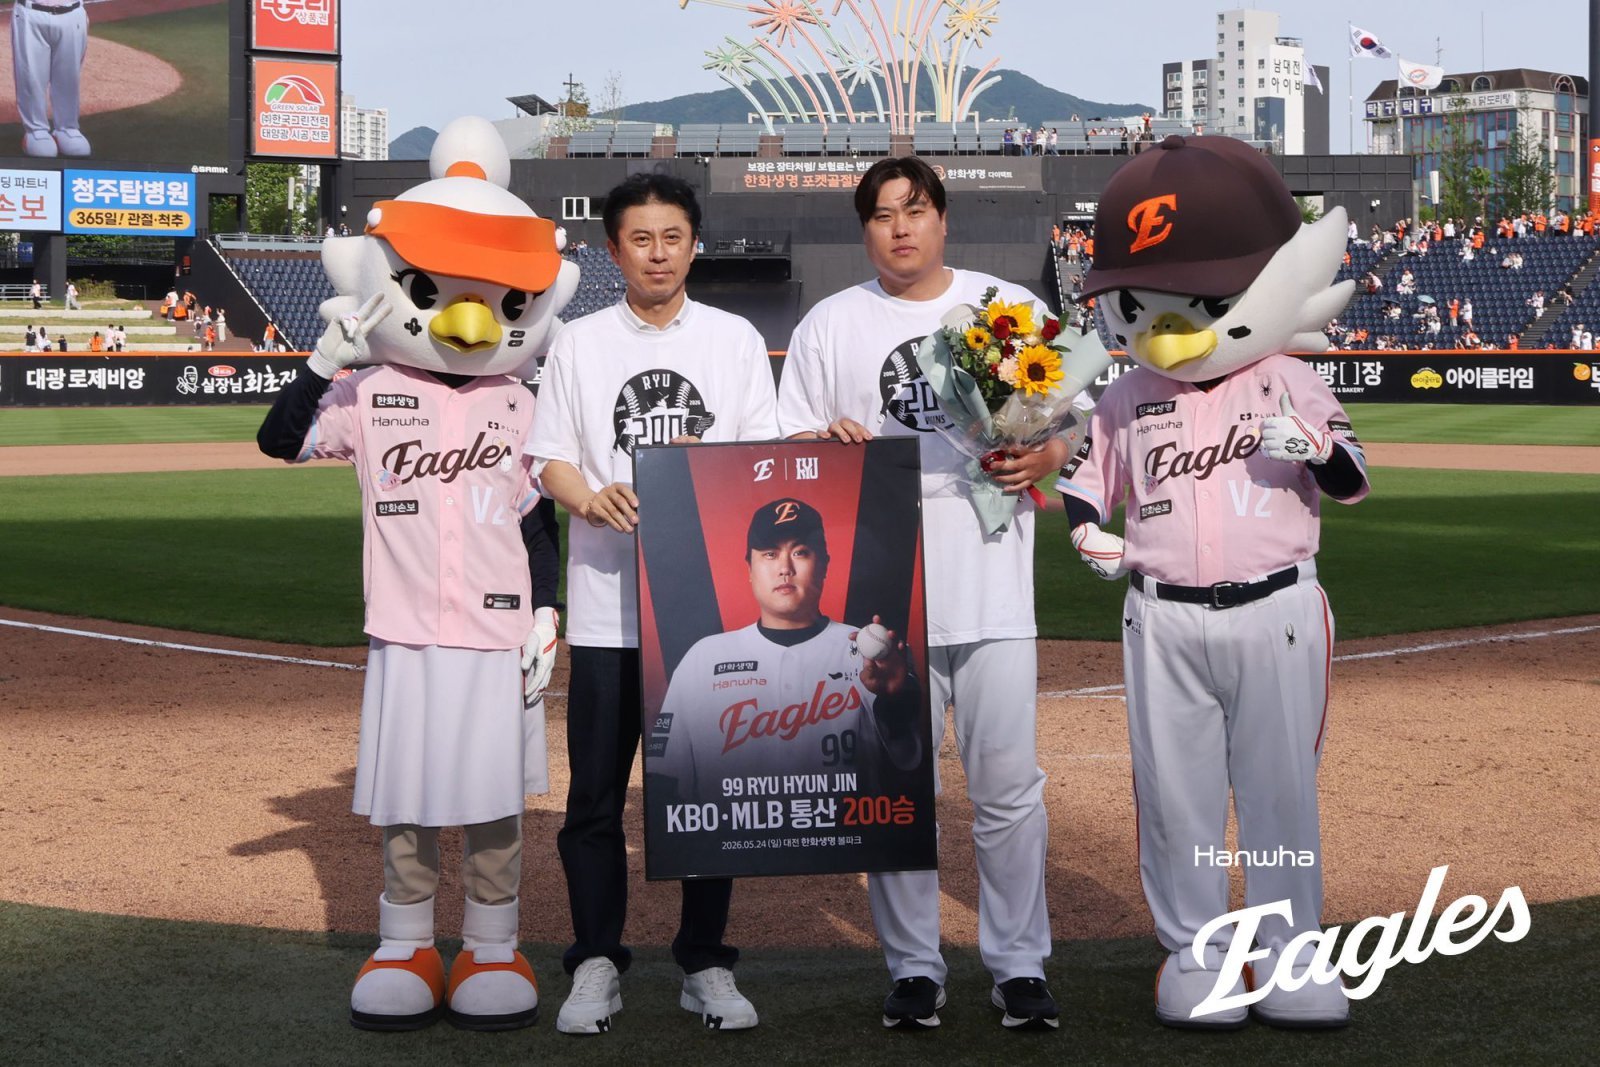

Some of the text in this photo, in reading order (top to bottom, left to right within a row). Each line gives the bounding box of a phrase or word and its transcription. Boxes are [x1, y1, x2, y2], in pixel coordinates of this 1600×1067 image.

[297, 12, 329, 24] 상품권
[1273, 59, 1301, 76] 남대전
[261, 128, 329, 141] 태양광 시공 전문
[747, 161, 776, 172] 보장은
[776, 161, 816, 173] 장타처럼!
[817, 161, 855, 172] 보험료는
[946, 168, 986, 180] 한화생명
[15, 176, 48, 190] 파트너
[743, 174, 799, 188] 한화생명
[71, 177, 189, 206] 청주탑병원
[76, 211, 124, 226] 365일!
[1127, 193, 1178, 255] E
[25, 368, 66, 391] 대광
[67, 368, 146, 390] 로제비앙
[200, 377, 243, 395] 실장님
[641, 373, 671, 391] RYU
[1445, 366, 1535, 390] 아이클타임
[1341, 386, 1365, 394] BAKERY
[376, 396, 416, 408] 한화생명
[371, 416, 430, 427] Hanwha
[1136, 420, 1184, 437] Hanwha
[753, 458, 775, 482] E
[1227, 479, 1273, 518] V2
[378, 502, 417, 515] 한화손보
[717, 661, 755, 673] 한화생명
[712, 677, 768, 692] Hanwha
[718, 680, 861, 757] Eagles
[821, 729, 857, 768] 99
[721, 773, 857, 797] 99 RYU HYUN JIN
[789, 798, 838, 830] 통산
[843, 795, 916, 826] 200승
[783, 837, 800, 848] 대전
[801, 836, 836, 848] 한화생명
[837, 835, 862, 846] 볼파크
